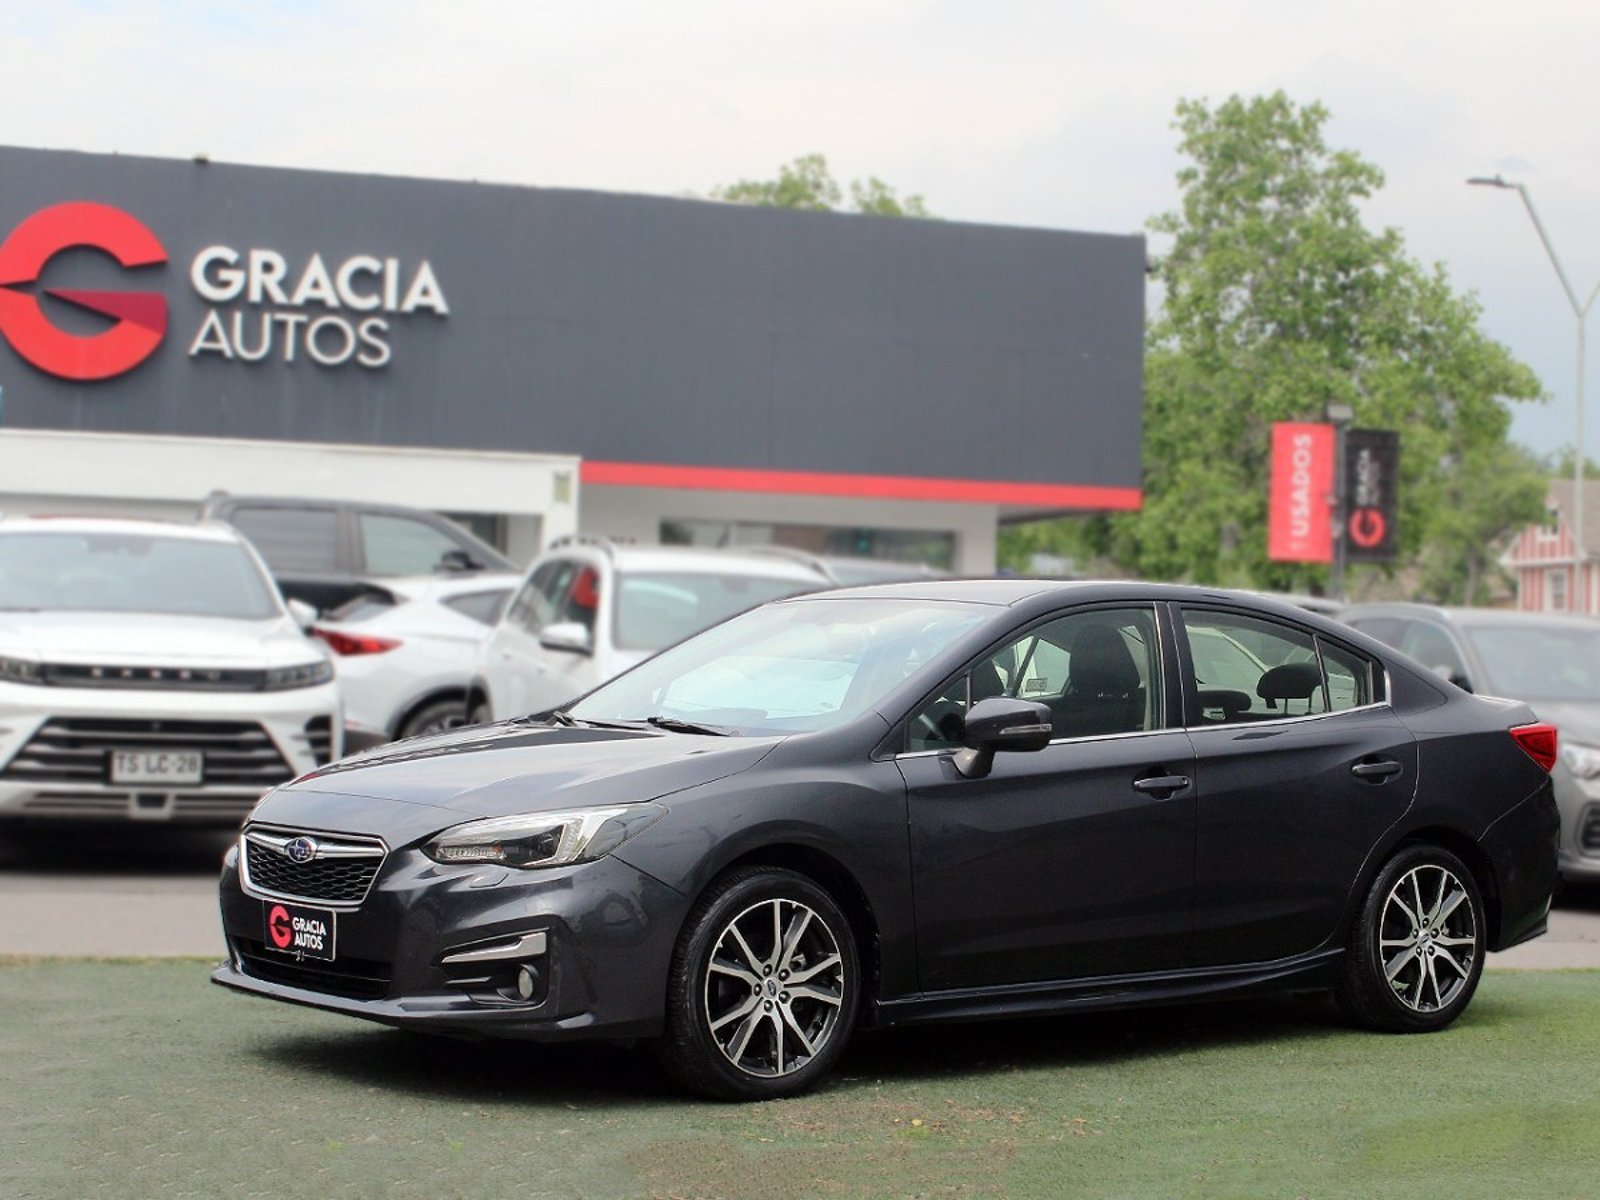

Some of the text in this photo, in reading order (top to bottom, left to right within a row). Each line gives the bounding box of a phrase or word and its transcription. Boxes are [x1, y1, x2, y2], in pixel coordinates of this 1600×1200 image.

[191, 245, 449, 316] GRACIA
[188, 308, 392, 368] AUTOS
[1289, 433, 1313, 538] USADOS
[292, 916, 327, 936] GRACIA
[294, 931, 323, 951] AUTOS
